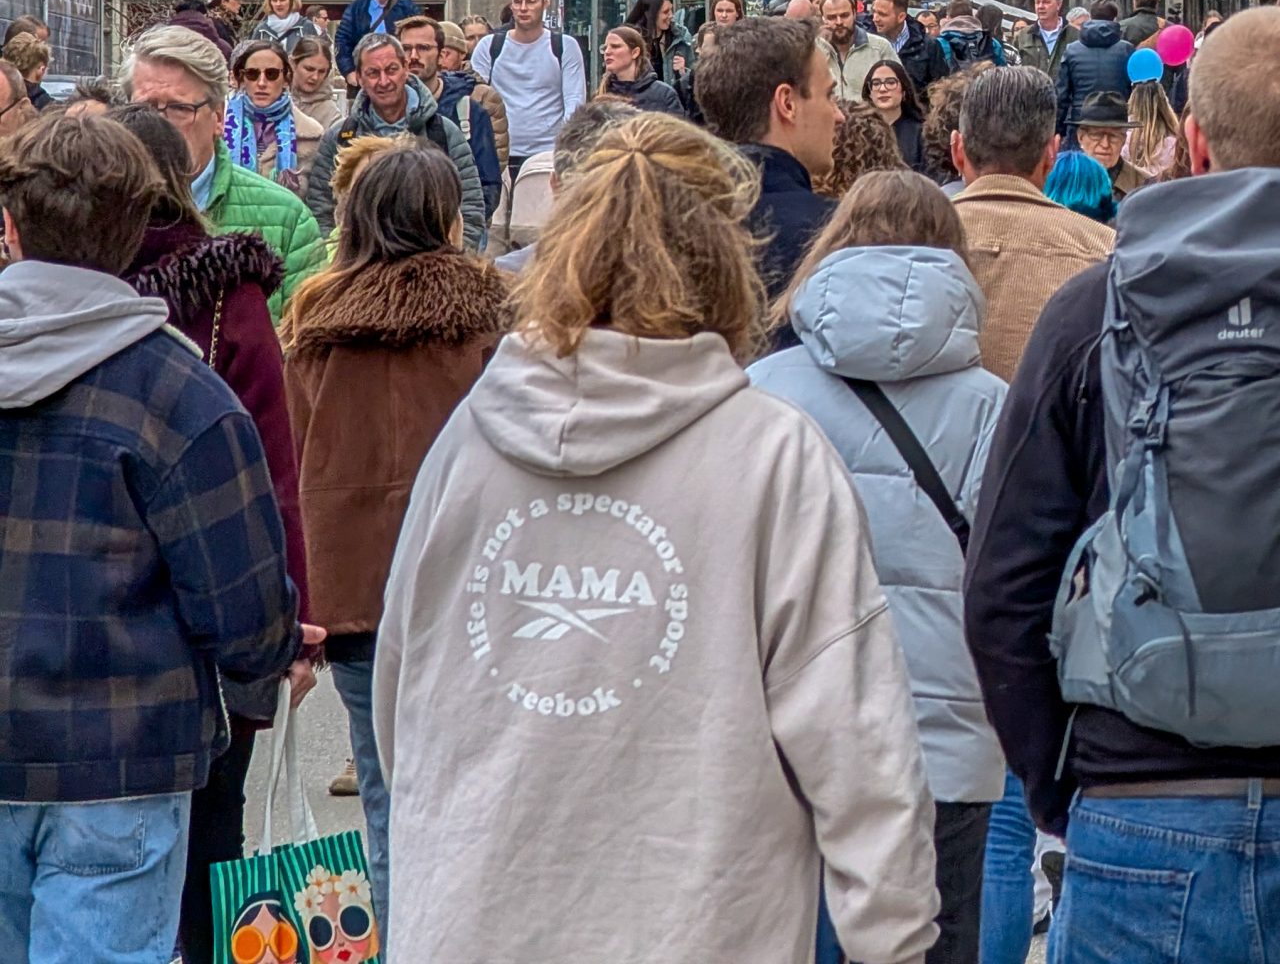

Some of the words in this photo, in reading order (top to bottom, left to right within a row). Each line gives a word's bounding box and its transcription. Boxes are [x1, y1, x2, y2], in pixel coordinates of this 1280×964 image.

[1217, 328, 1265, 341] deuter
[529, 498, 549, 518] a
[482, 508, 525, 561] not
[557, 493, 684, 574] spectator
[467, 565, 490, 593] is
[500, 560, 657, 606] MAMA
[467, 602, 491, 661] life
[649, 583, 688, 674] sport
[507, 683, 622, 717] reebok
